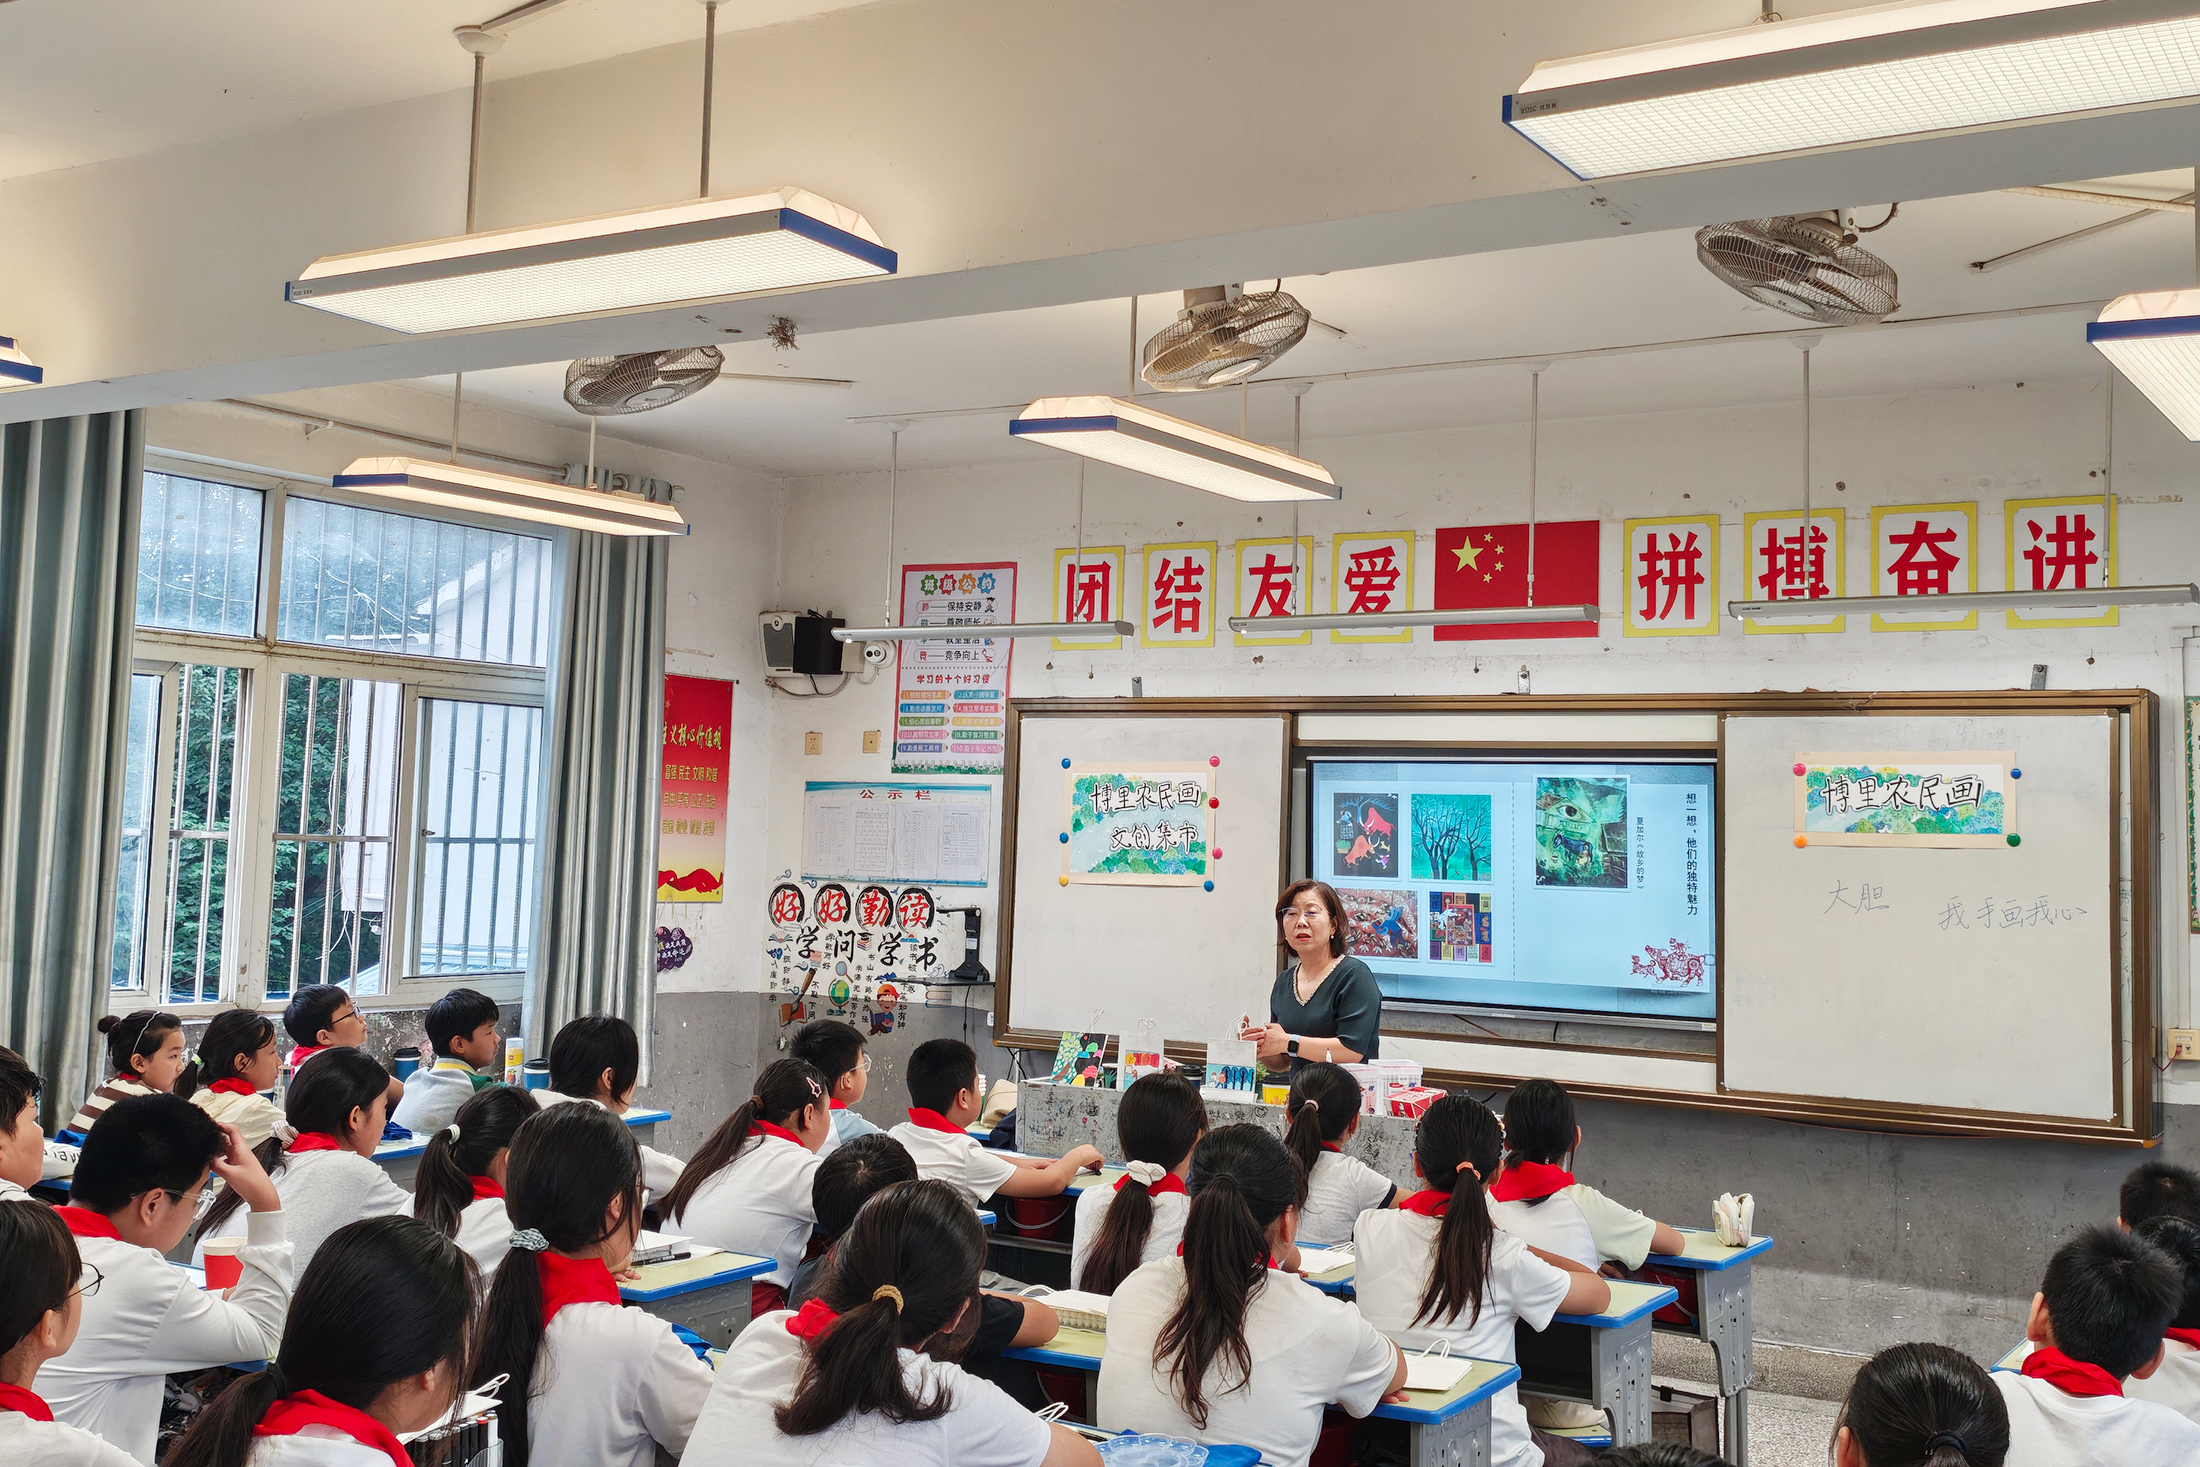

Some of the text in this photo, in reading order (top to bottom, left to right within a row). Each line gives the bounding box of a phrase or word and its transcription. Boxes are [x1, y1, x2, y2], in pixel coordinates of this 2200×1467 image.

[922, 576, 994, 592] 班级公约
[1638, 515, 2099, 622] 拼搏奋进
[1066, 546, 1401, 633] 团结友爱
[916, 674, 990, 685] 学习的十个好习惯
[665, 764, 718, 783] 富强 民主 文明 和谐
[663, 791, 675, 807] 自由
[677, 791, 689, 808] 平等
[859, 789, 931, 801] 公示栏
[1090, 782, 1200, 813] 博里农民画
[1821, 775, 1983, 814] 博里农民画
[1111, 820, 1198, 852] 文创集市
[1685, 792, 1698, 916] 想一想，他们的独特魅力
[1822, 879, 1890, 915] 大胆
[1937, 895, 2088, 931] 我手画我心
